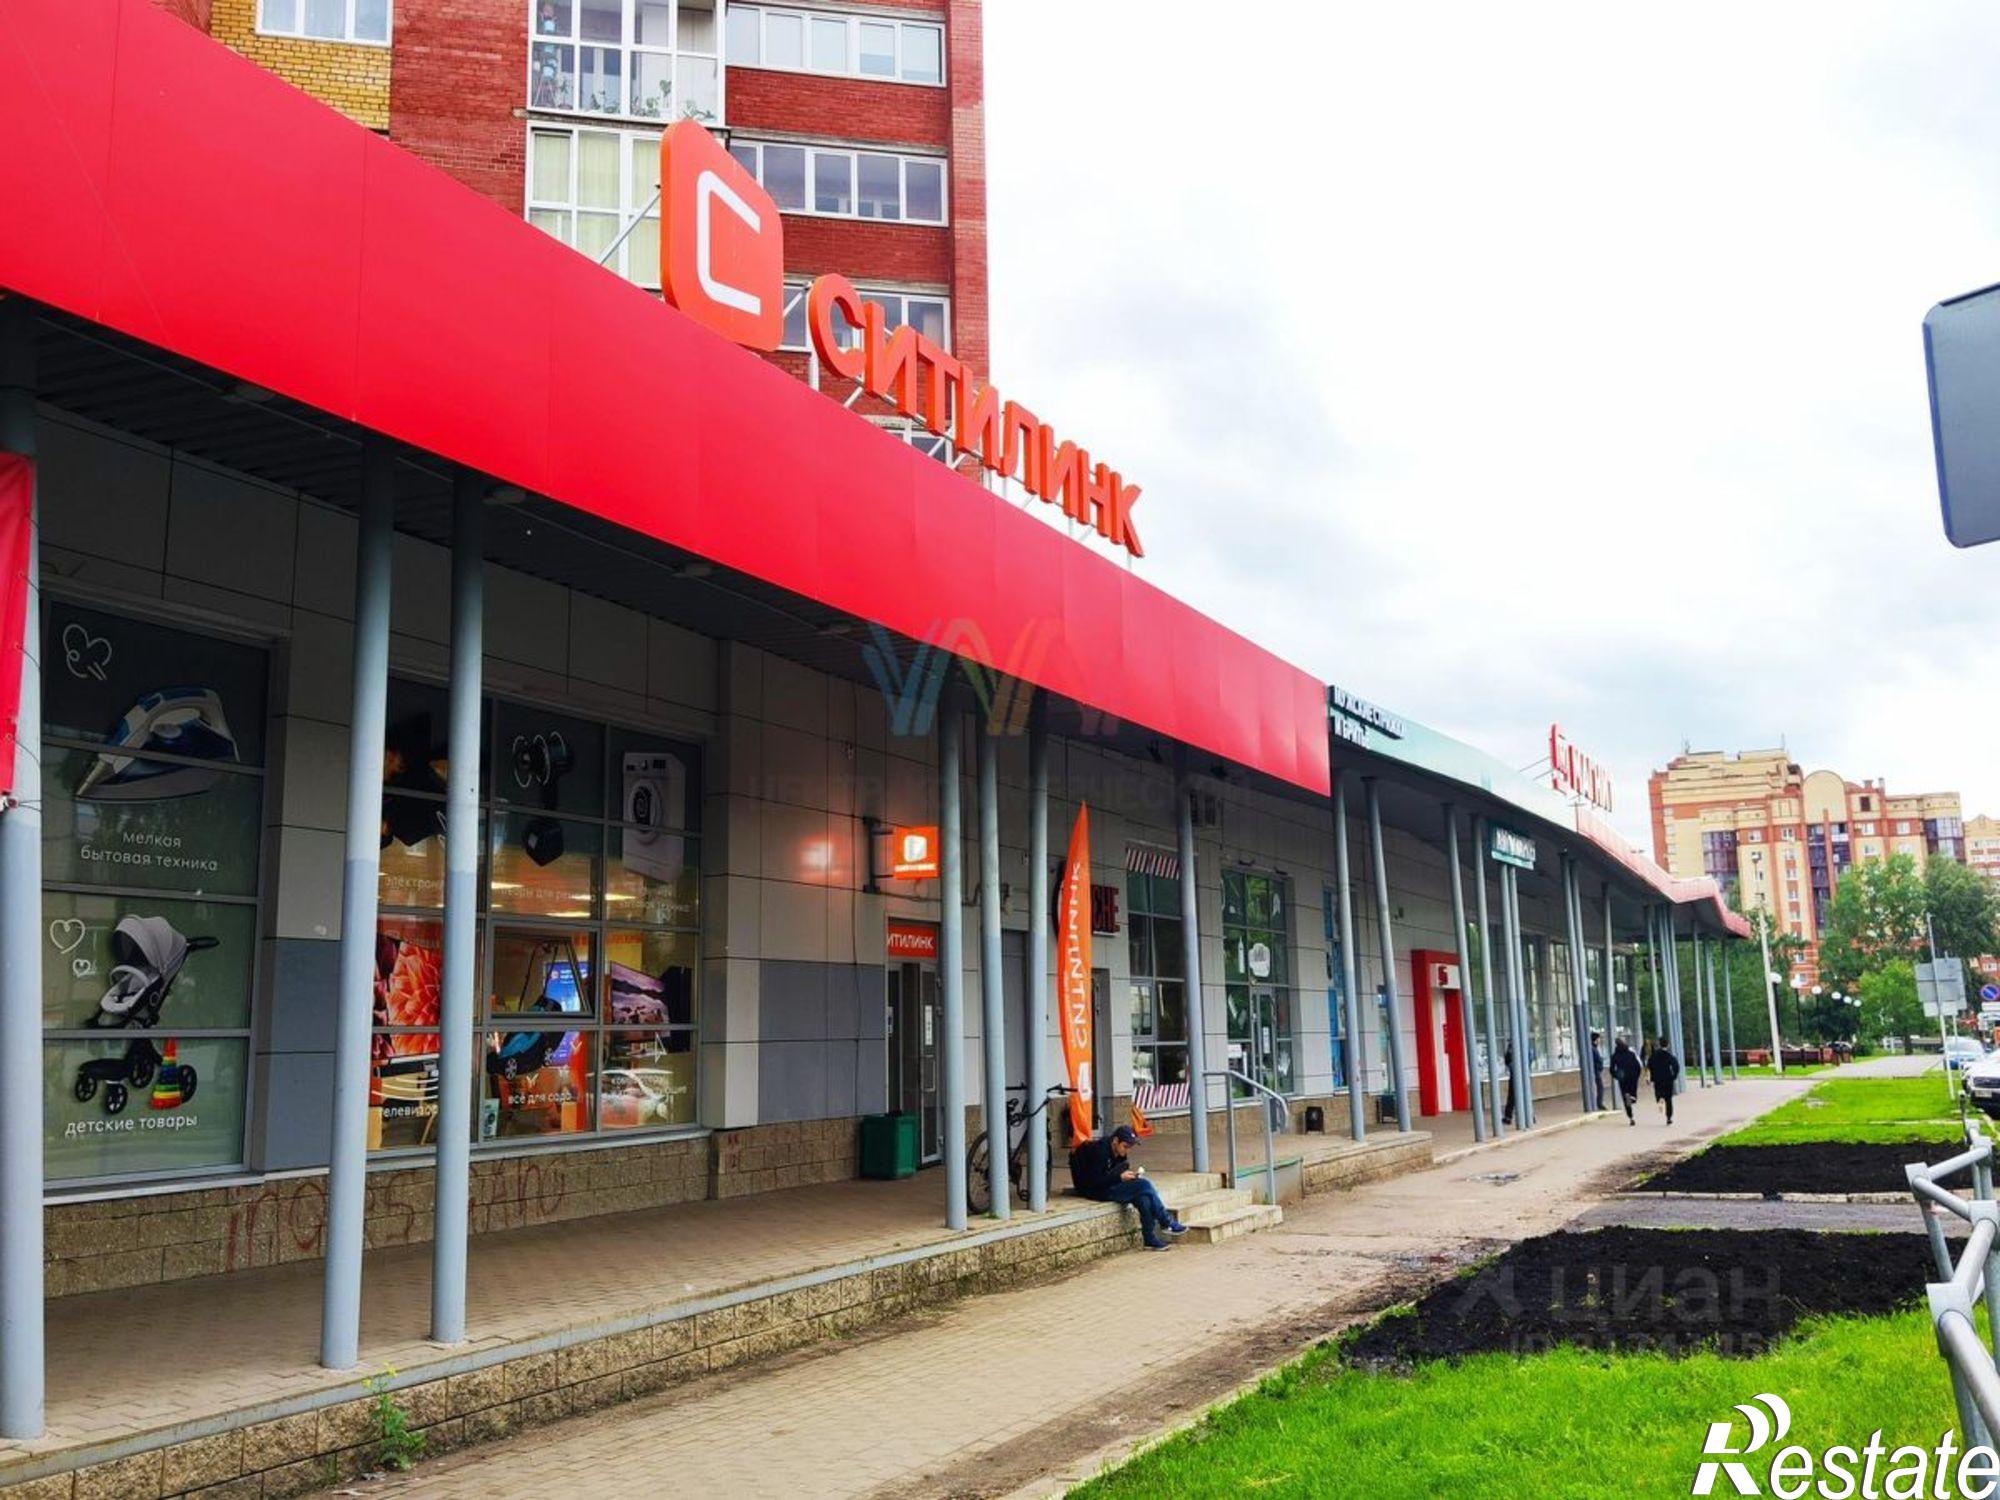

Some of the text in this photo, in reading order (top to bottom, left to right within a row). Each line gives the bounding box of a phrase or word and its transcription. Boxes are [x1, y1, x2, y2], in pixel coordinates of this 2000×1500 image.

[808, 273, 1145, 559] СИТИЛИНК
[122, 831, 182, 848] мелкая
[80, 844, 218, 871] бытовая техника
[886, 932, 934, 949] ИТИЛИНК
[65, 1115, 198, 1136] детские товары
